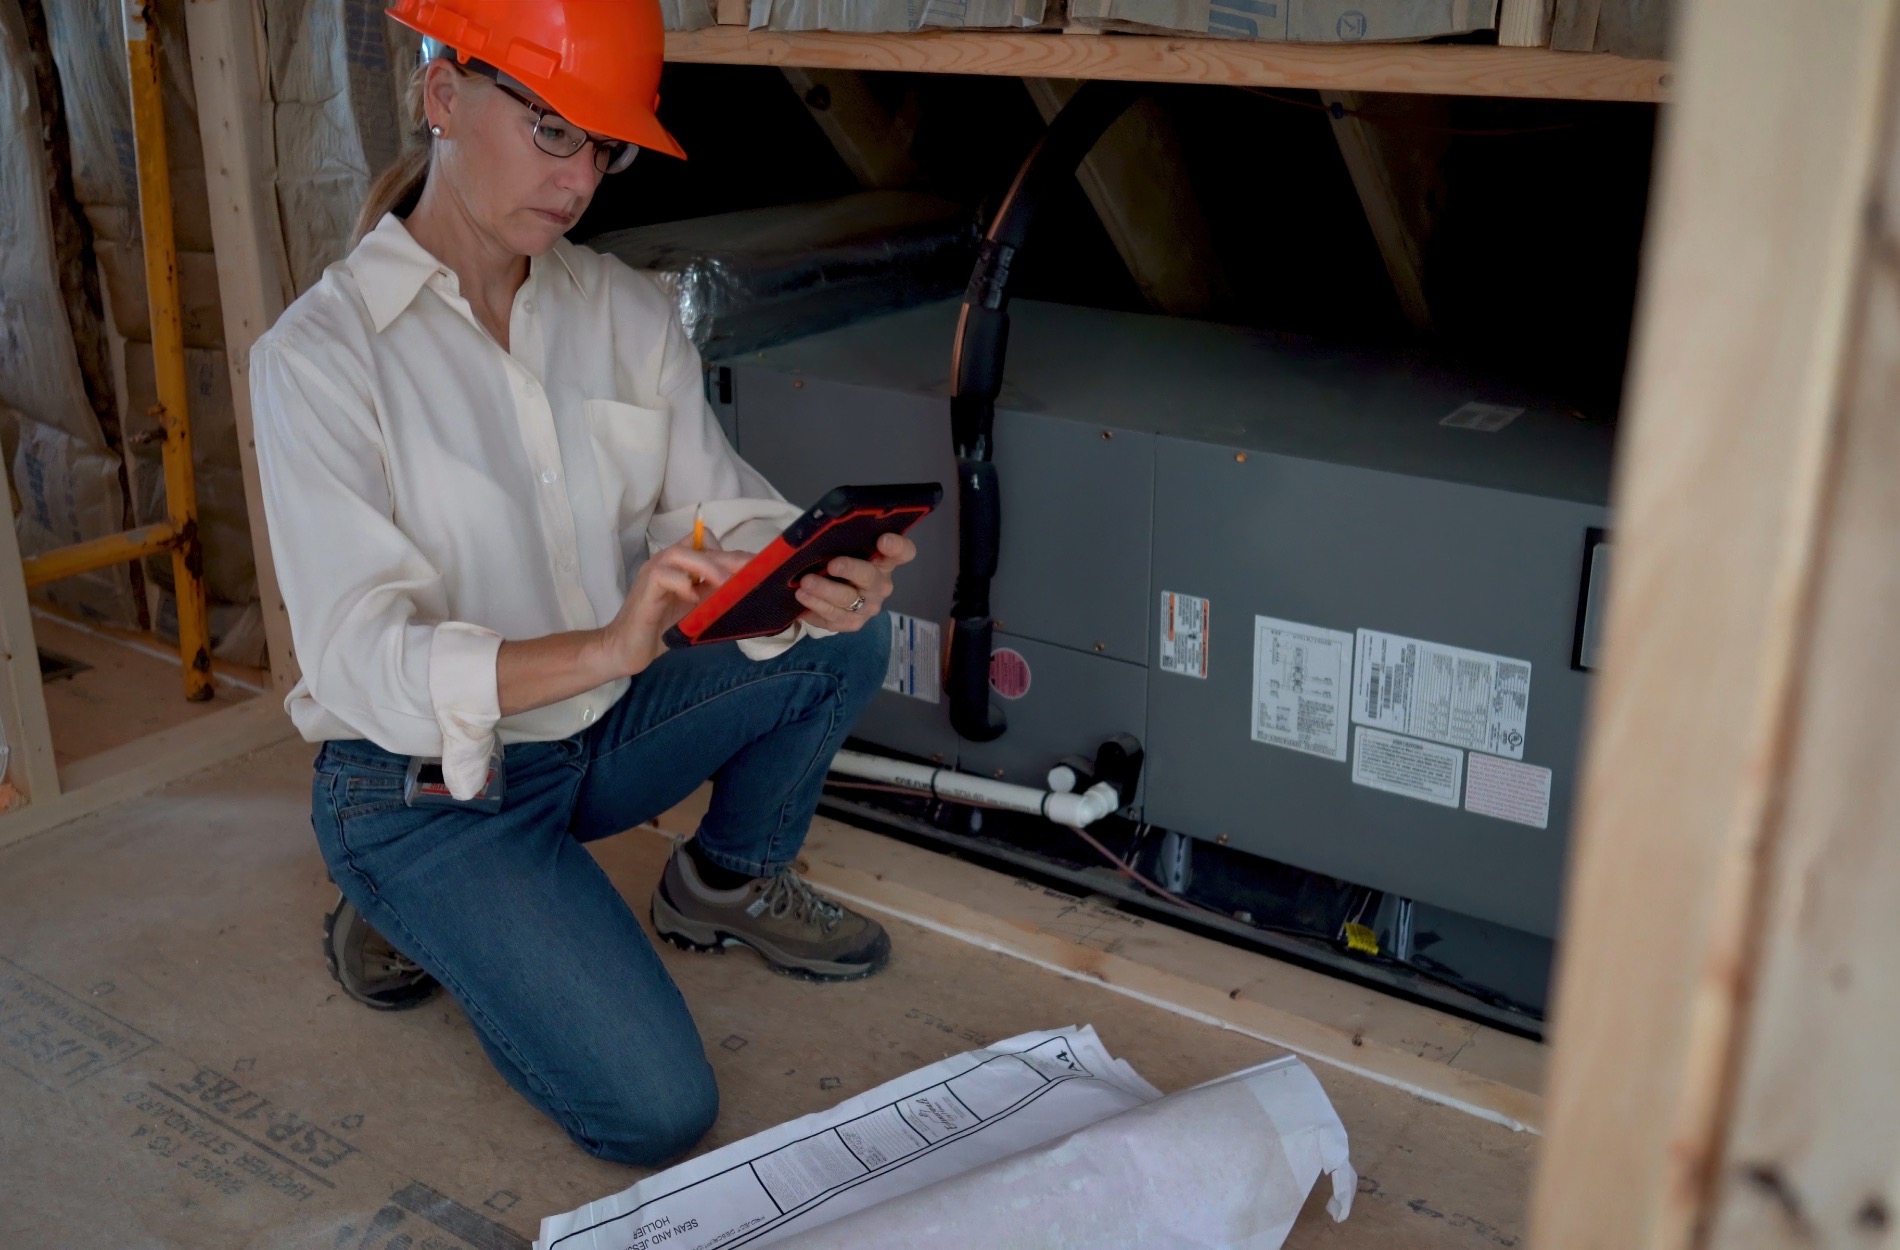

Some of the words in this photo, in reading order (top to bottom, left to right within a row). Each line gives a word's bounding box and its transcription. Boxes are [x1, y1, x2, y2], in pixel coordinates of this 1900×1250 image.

[1056, 1050, 1082, 1072] A4
[122, 1090, 238, 1156] STANDARD
[233, 1153, 314, 1201] HIGHER
[674, 1218, 699, 1237] SEAN
[734, 1215, 766, 1234] PROJECT
[651, 1231, 673, 1245] AND
